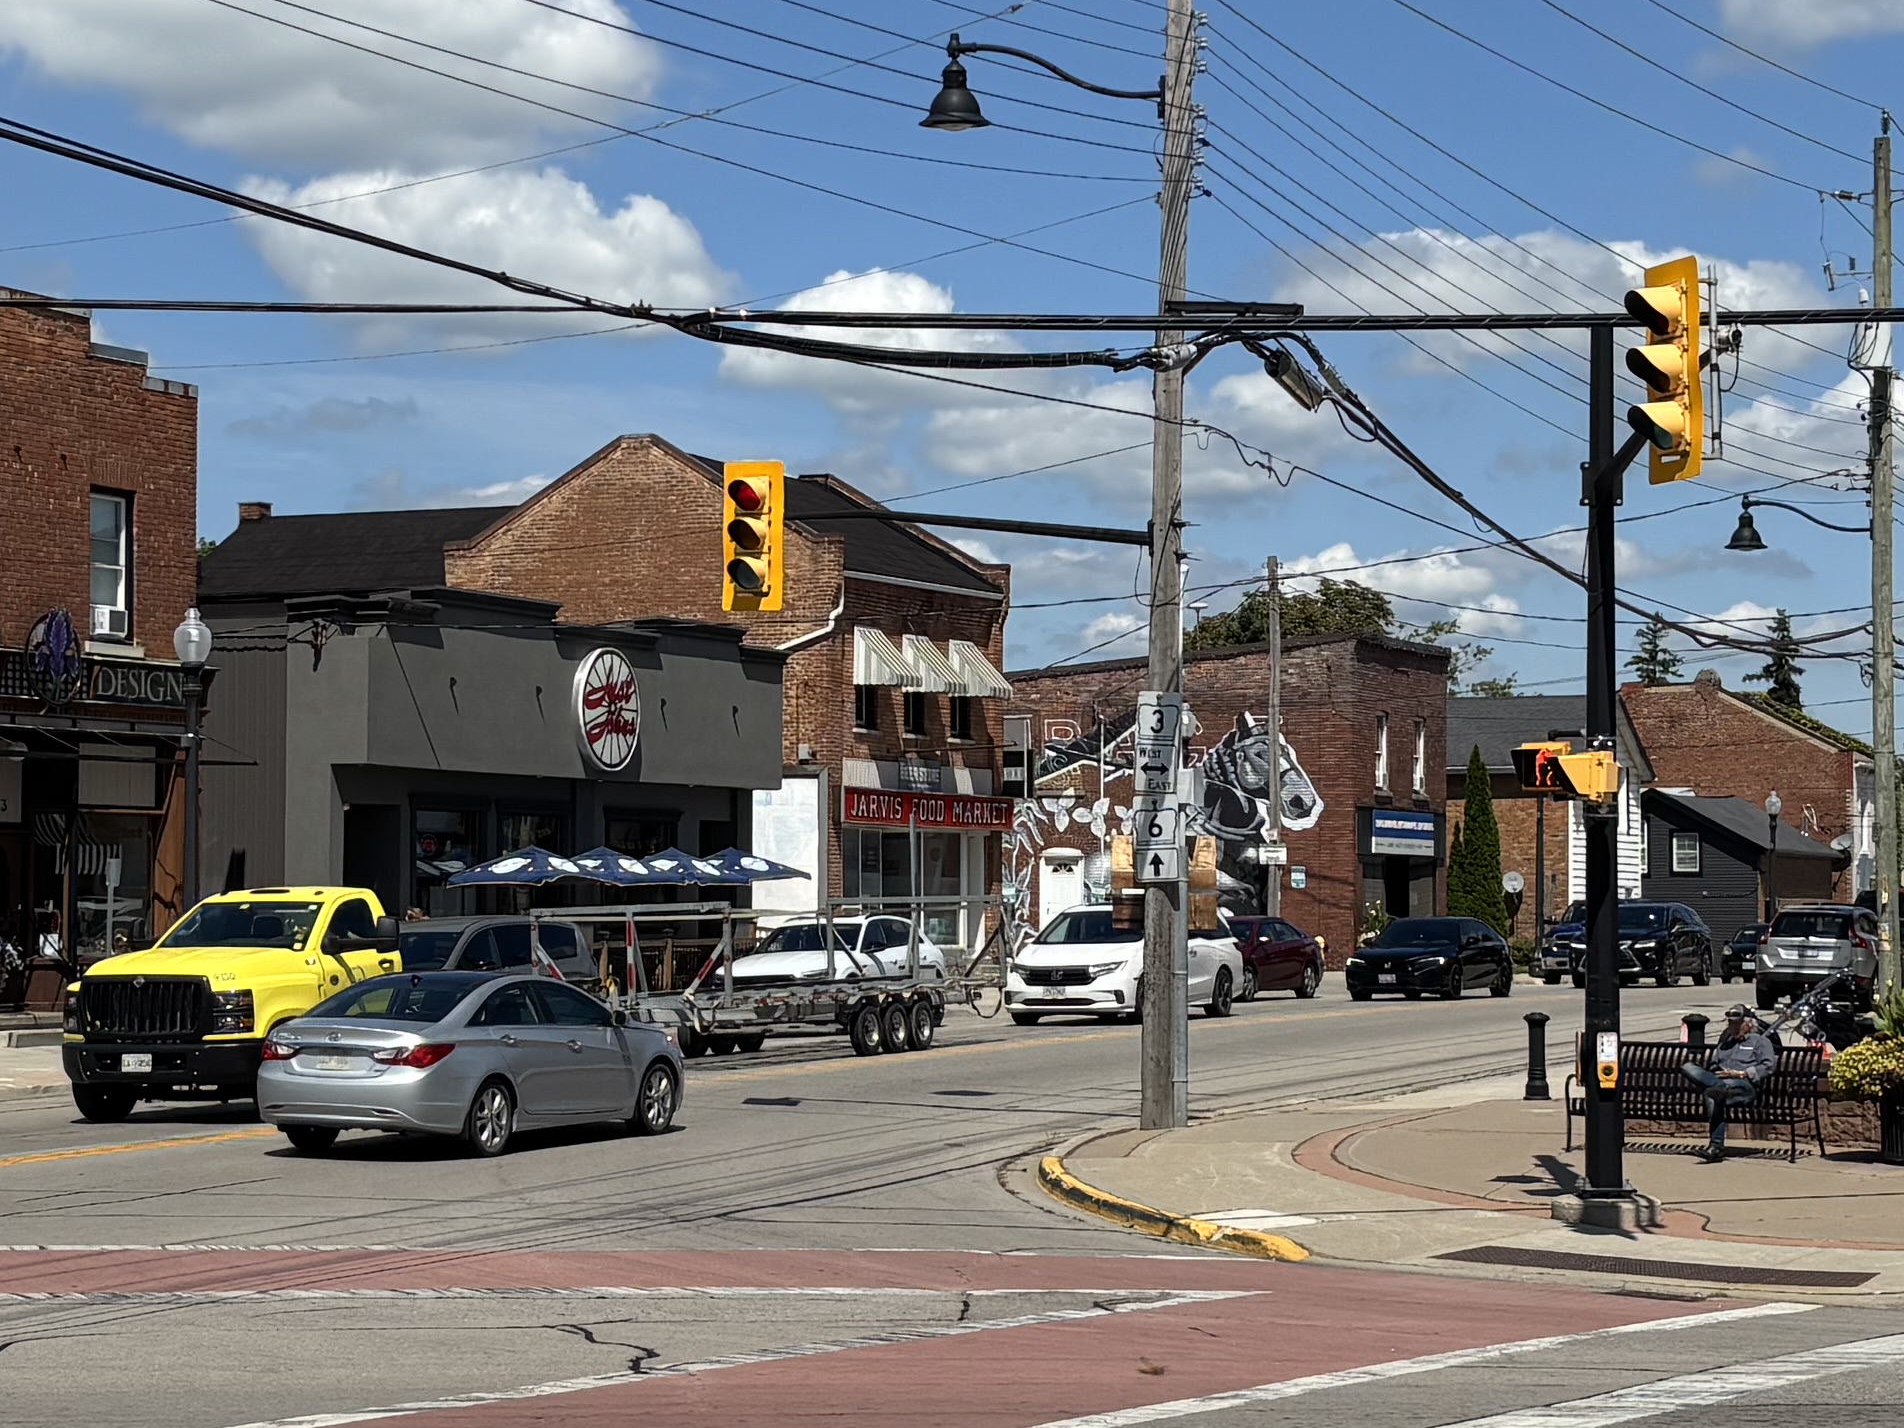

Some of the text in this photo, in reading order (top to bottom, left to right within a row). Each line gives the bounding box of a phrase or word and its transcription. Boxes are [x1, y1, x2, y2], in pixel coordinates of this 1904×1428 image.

[97, 668, 186, 703] DESIGN
[1150, 709, 1165, 734] 3
[1148, 778, 1171, 791] EAST
[850, 793, 1008, 824] JARVIS FOOD MARKET
[1148, 813, 1163, 838] 6
